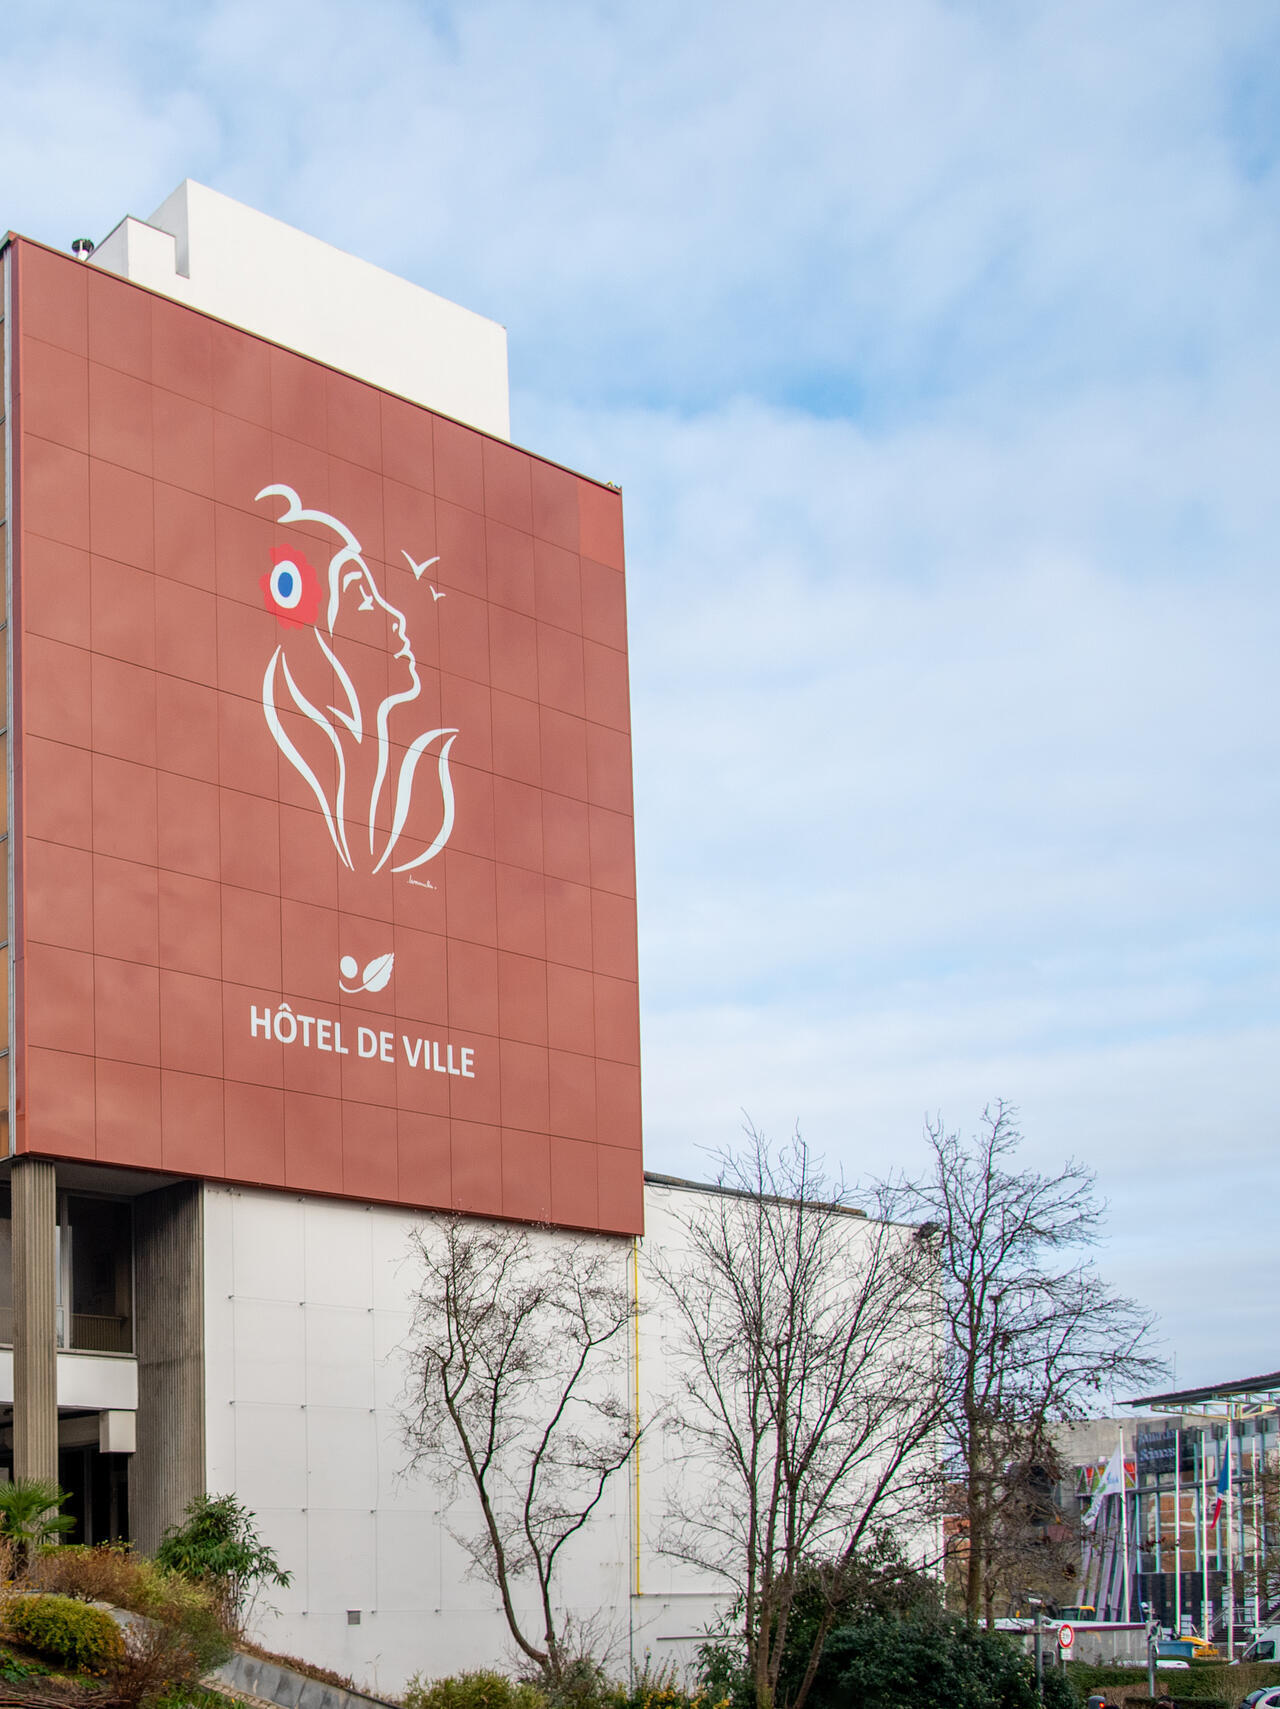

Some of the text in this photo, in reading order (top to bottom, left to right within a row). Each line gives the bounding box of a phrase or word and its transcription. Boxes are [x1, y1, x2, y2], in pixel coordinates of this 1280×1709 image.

[250, 1002, 475, 1079] HÔTEL DE VILLE
